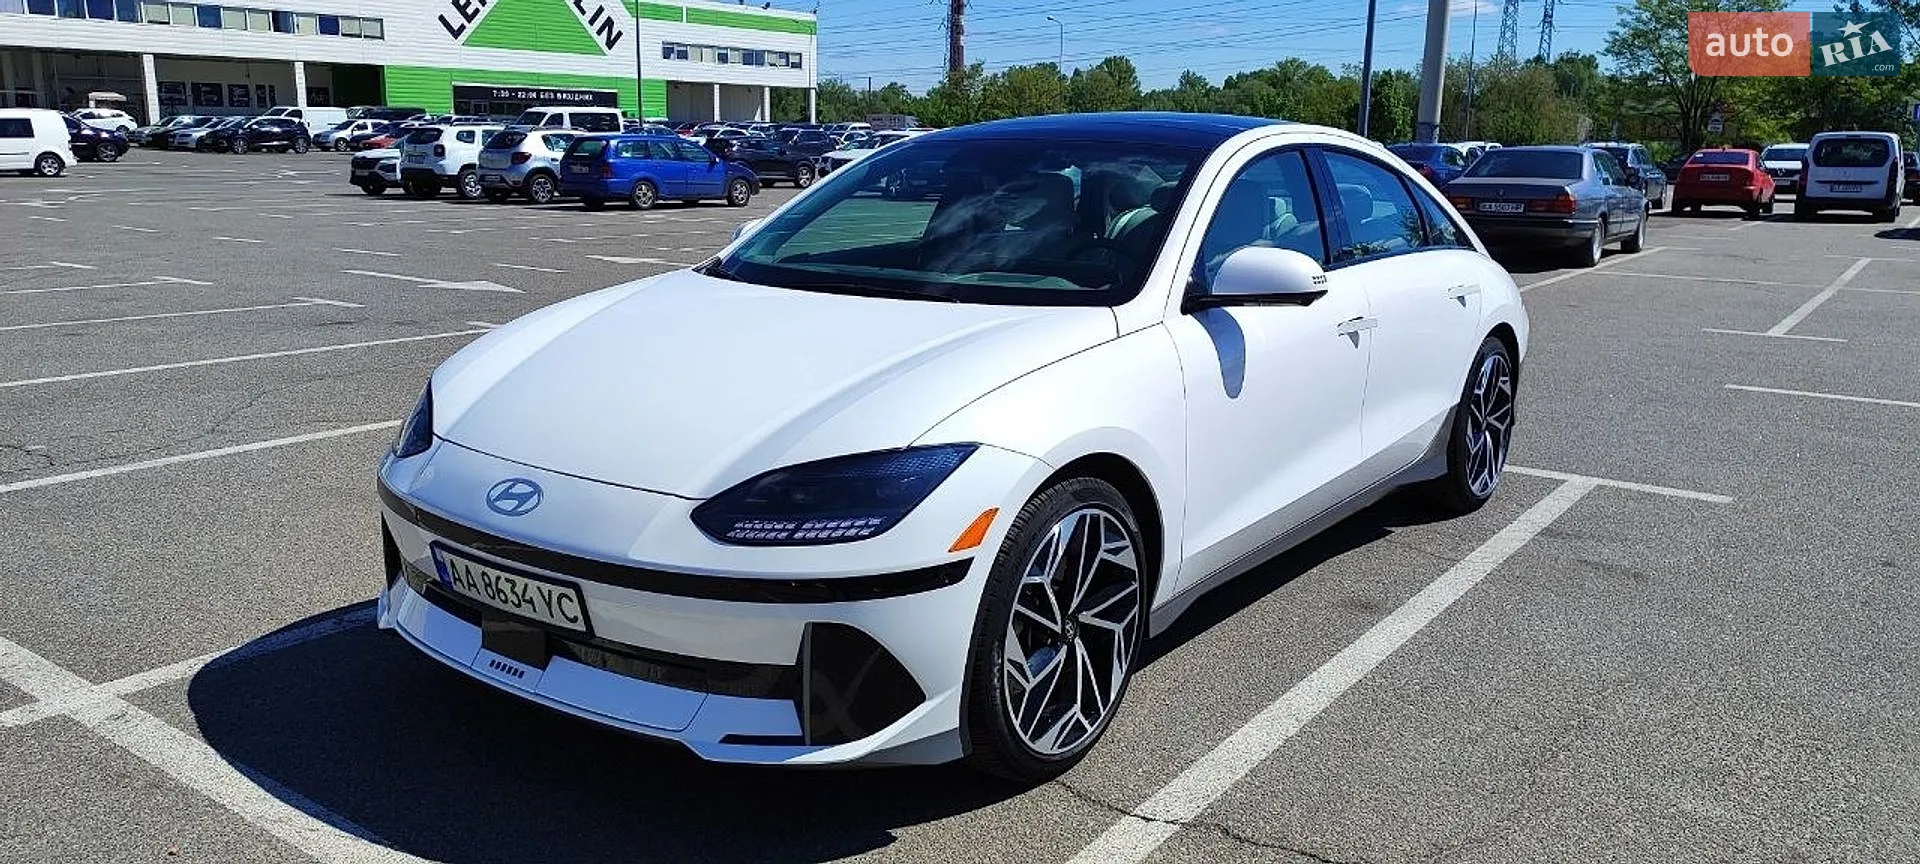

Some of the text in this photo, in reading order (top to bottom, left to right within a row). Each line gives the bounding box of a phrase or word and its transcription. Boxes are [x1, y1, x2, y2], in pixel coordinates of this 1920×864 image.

[449, 558, 579, 624] AA 8634 YC
